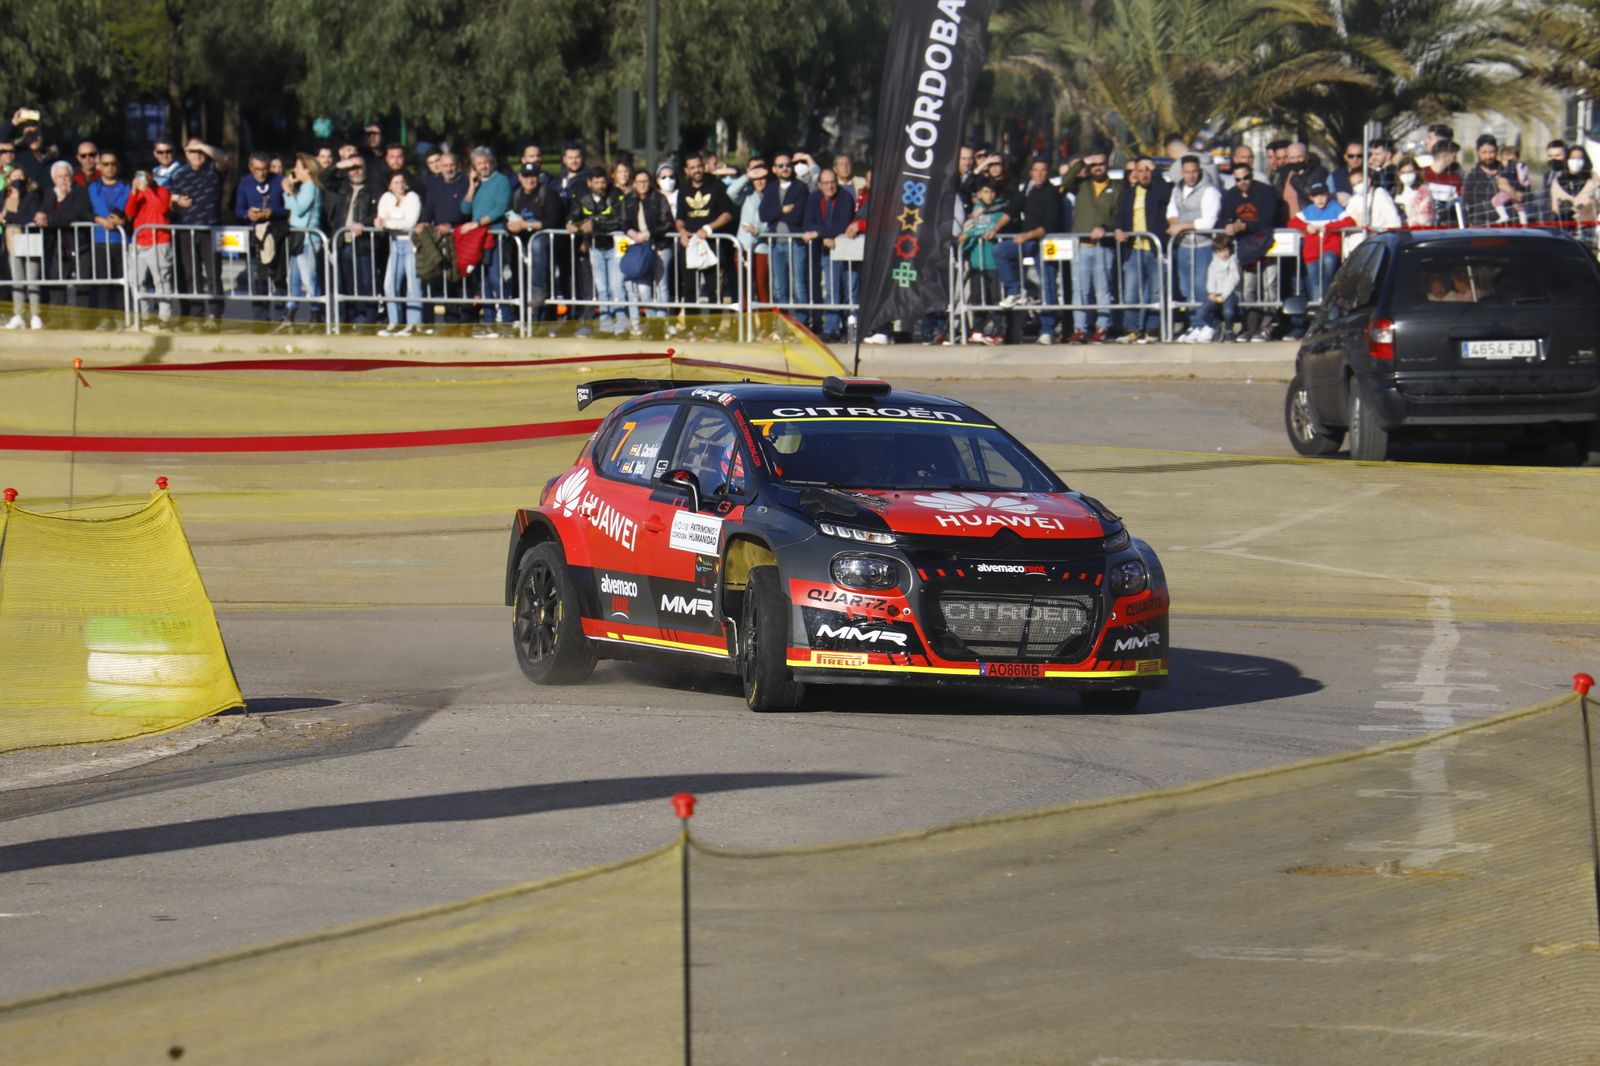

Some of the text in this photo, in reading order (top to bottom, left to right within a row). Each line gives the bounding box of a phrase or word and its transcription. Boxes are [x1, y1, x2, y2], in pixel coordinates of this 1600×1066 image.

[905, 0, 967, 170] CÓRDOBA
[1471, 343, 1534, 355] 4654 FJJ
[753, 421, 774, 437] 7
[610, 422, 637, 461] 7
[578, 490, 638, 553] HUAWEI
[935, 514, 1065, 531] HUAWEI
[688, 534, 717, 546] HUMANIDAD
[601, 574, 638, 597] alvemaco
[660, 594, 714, 618] MMR
[807, 588, 888, 611] QUARTZ
[816, 624, 908, 647] MMR
[1114, 632, 1160, 652] MMR
[989, 664, 1040, 676] AO86MB
